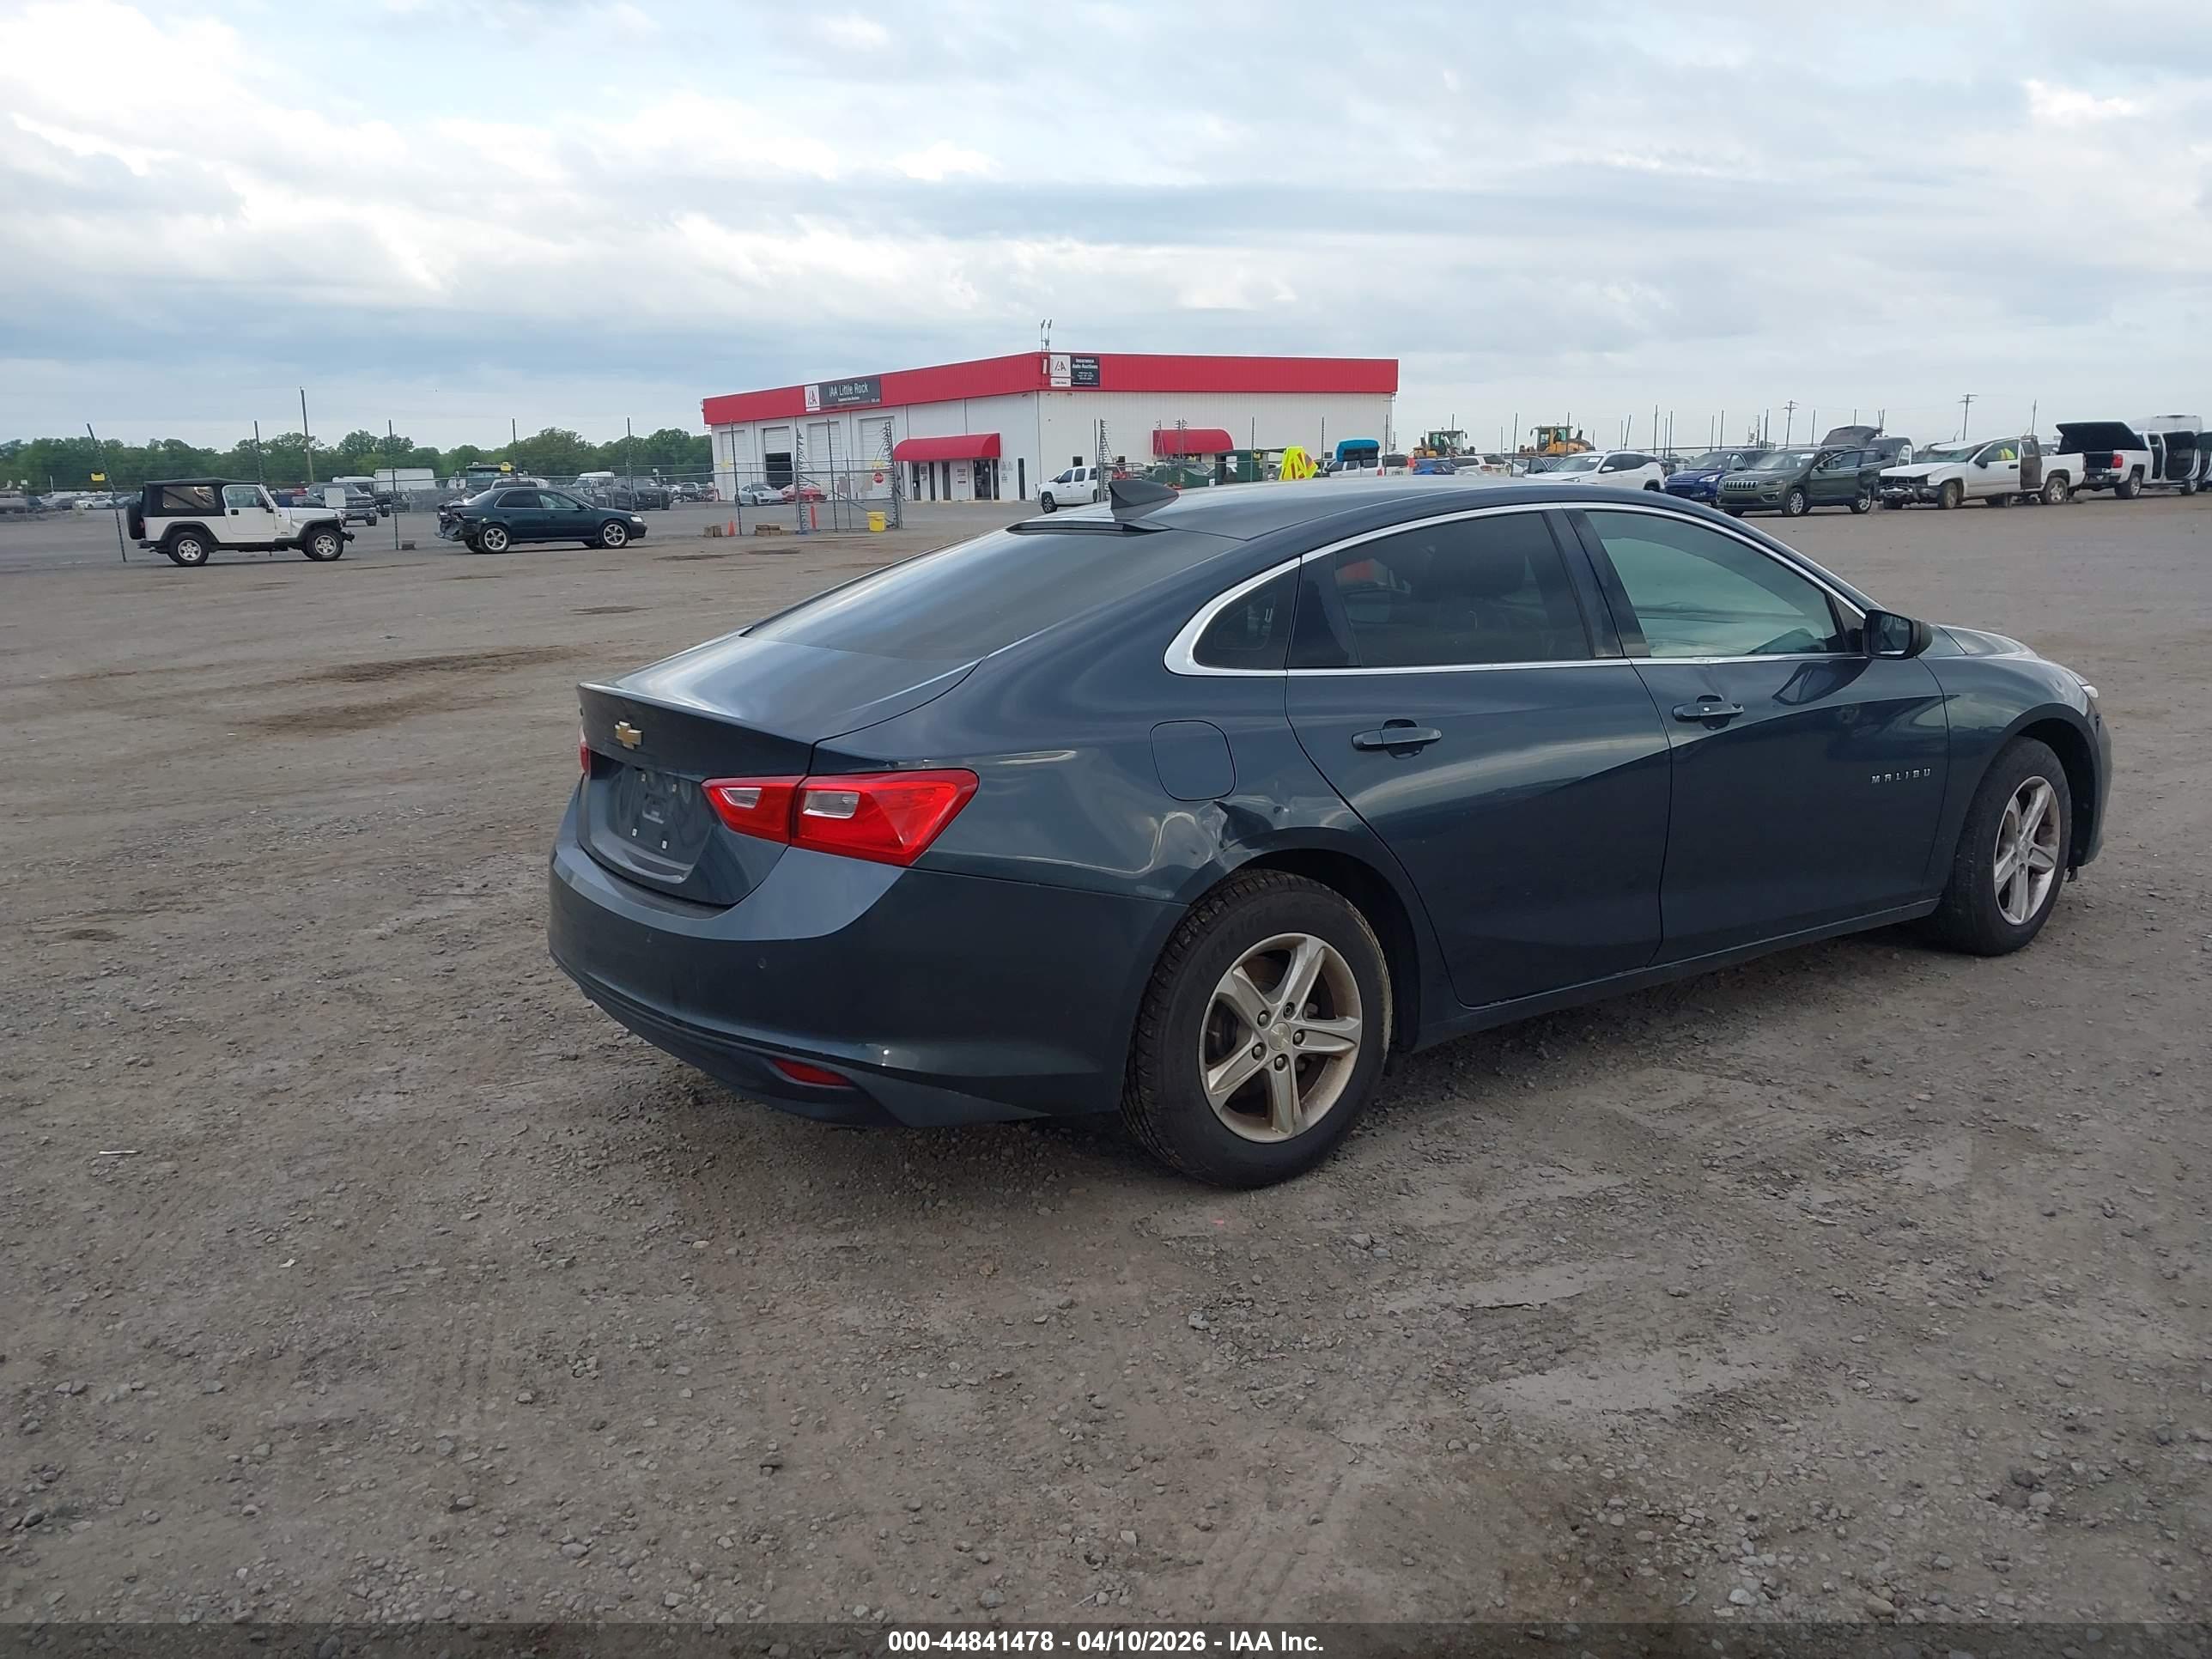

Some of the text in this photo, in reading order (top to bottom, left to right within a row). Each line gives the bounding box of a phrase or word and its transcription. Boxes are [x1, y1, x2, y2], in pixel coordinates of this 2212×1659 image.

[829, 382, 868, 397] IAA Little Rock
[1871, 768, 1931, 784] MALIBU
